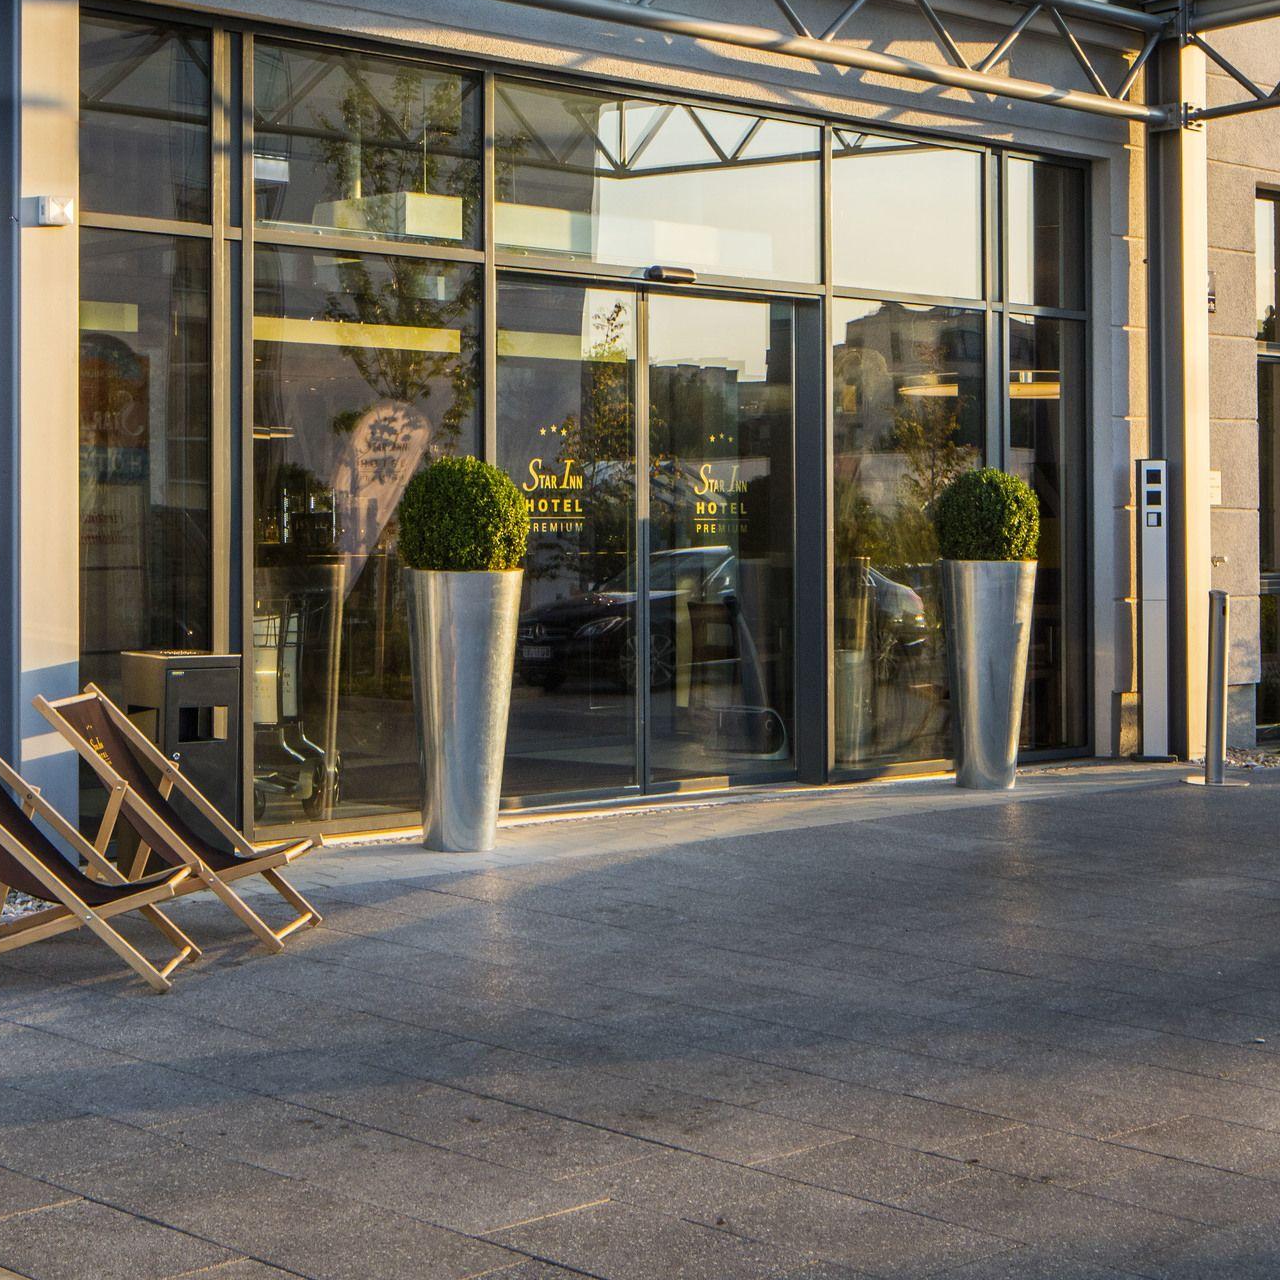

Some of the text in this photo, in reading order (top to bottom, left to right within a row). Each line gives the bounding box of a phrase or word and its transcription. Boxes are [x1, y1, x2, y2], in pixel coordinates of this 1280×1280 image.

[525, 498, 583, 513] HOTEL
[696, 501, 748, 515] HOTEL
[696, 523, 748, 534] PREMIUM
